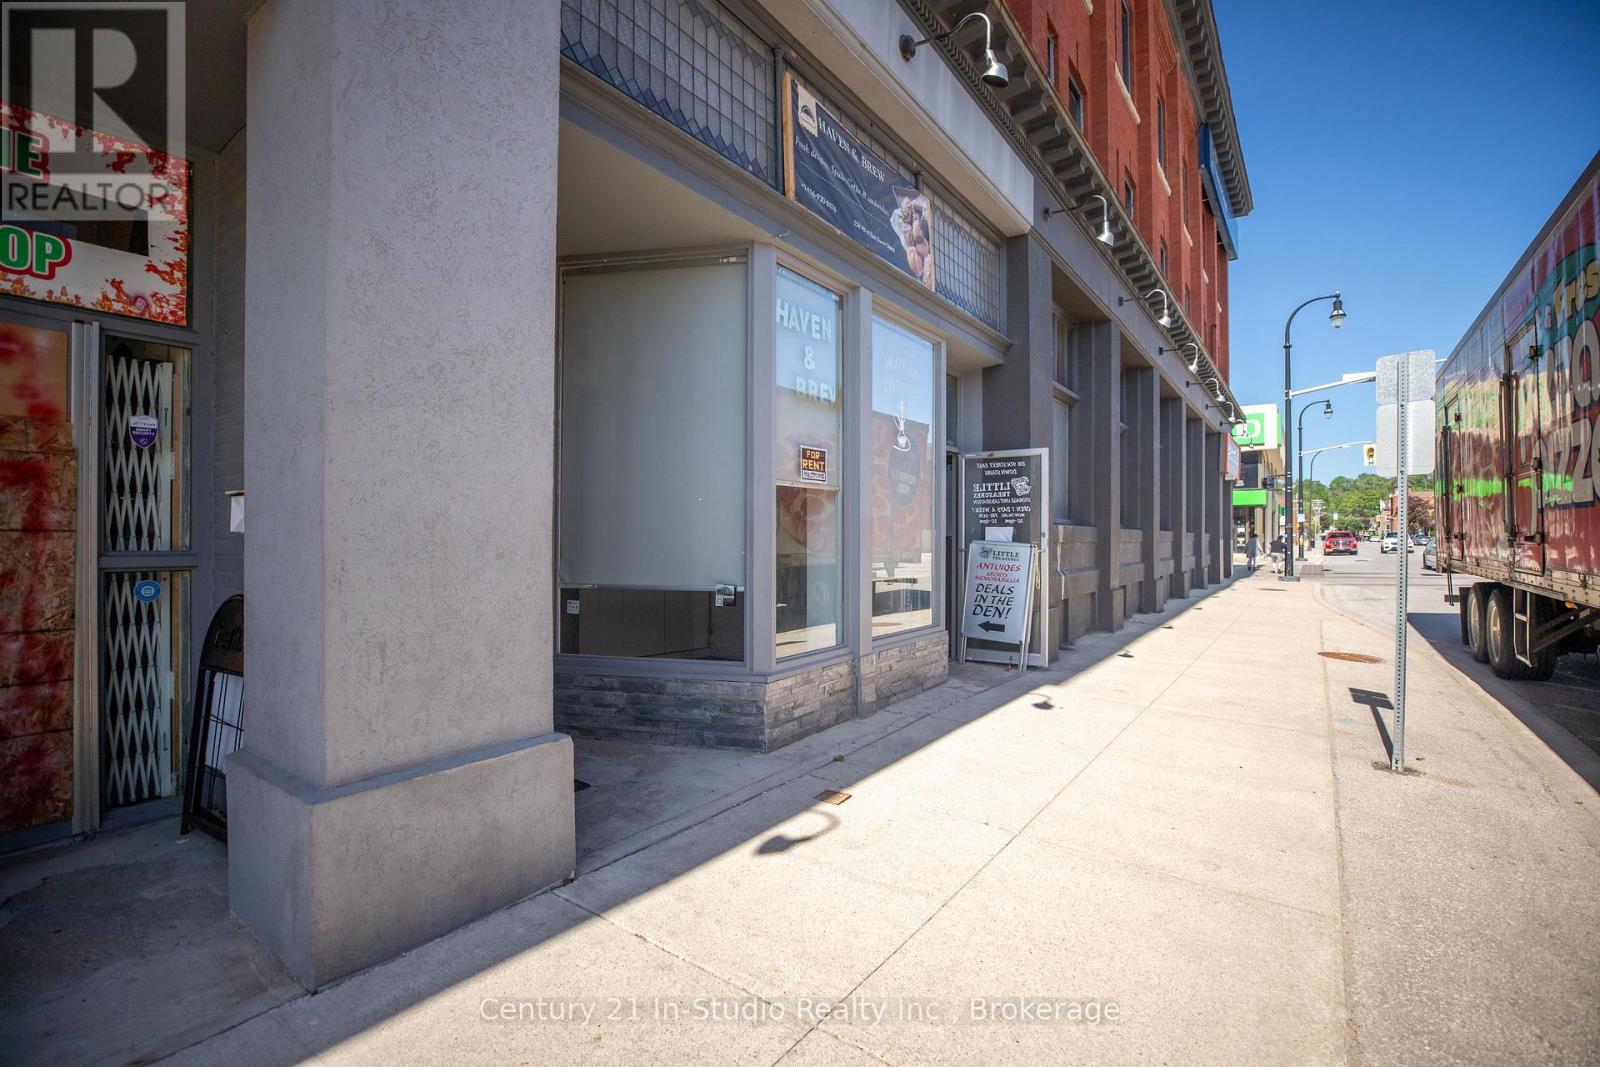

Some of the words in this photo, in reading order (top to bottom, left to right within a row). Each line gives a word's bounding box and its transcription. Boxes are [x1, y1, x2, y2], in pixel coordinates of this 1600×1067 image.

[818, 117, 851, 155] HAVEN
[861, 155, 886, 183] BREW
[776, 297, 832, 342] HAVEN
[804, 345, 816, 370] &
[806, 450, 820, 460] FOR
[802, 459, 825, 472] RENT
[992, 550, 1020, 558] LITTLE
[975, 562, 1021, 572] ANTUIQES
[975, 583, 1015, 595] DEALS
[974, 594, 989, 604] IN
[991, 595, 1015, 606] THE
[971, 604, 1012, 620] DEN!
